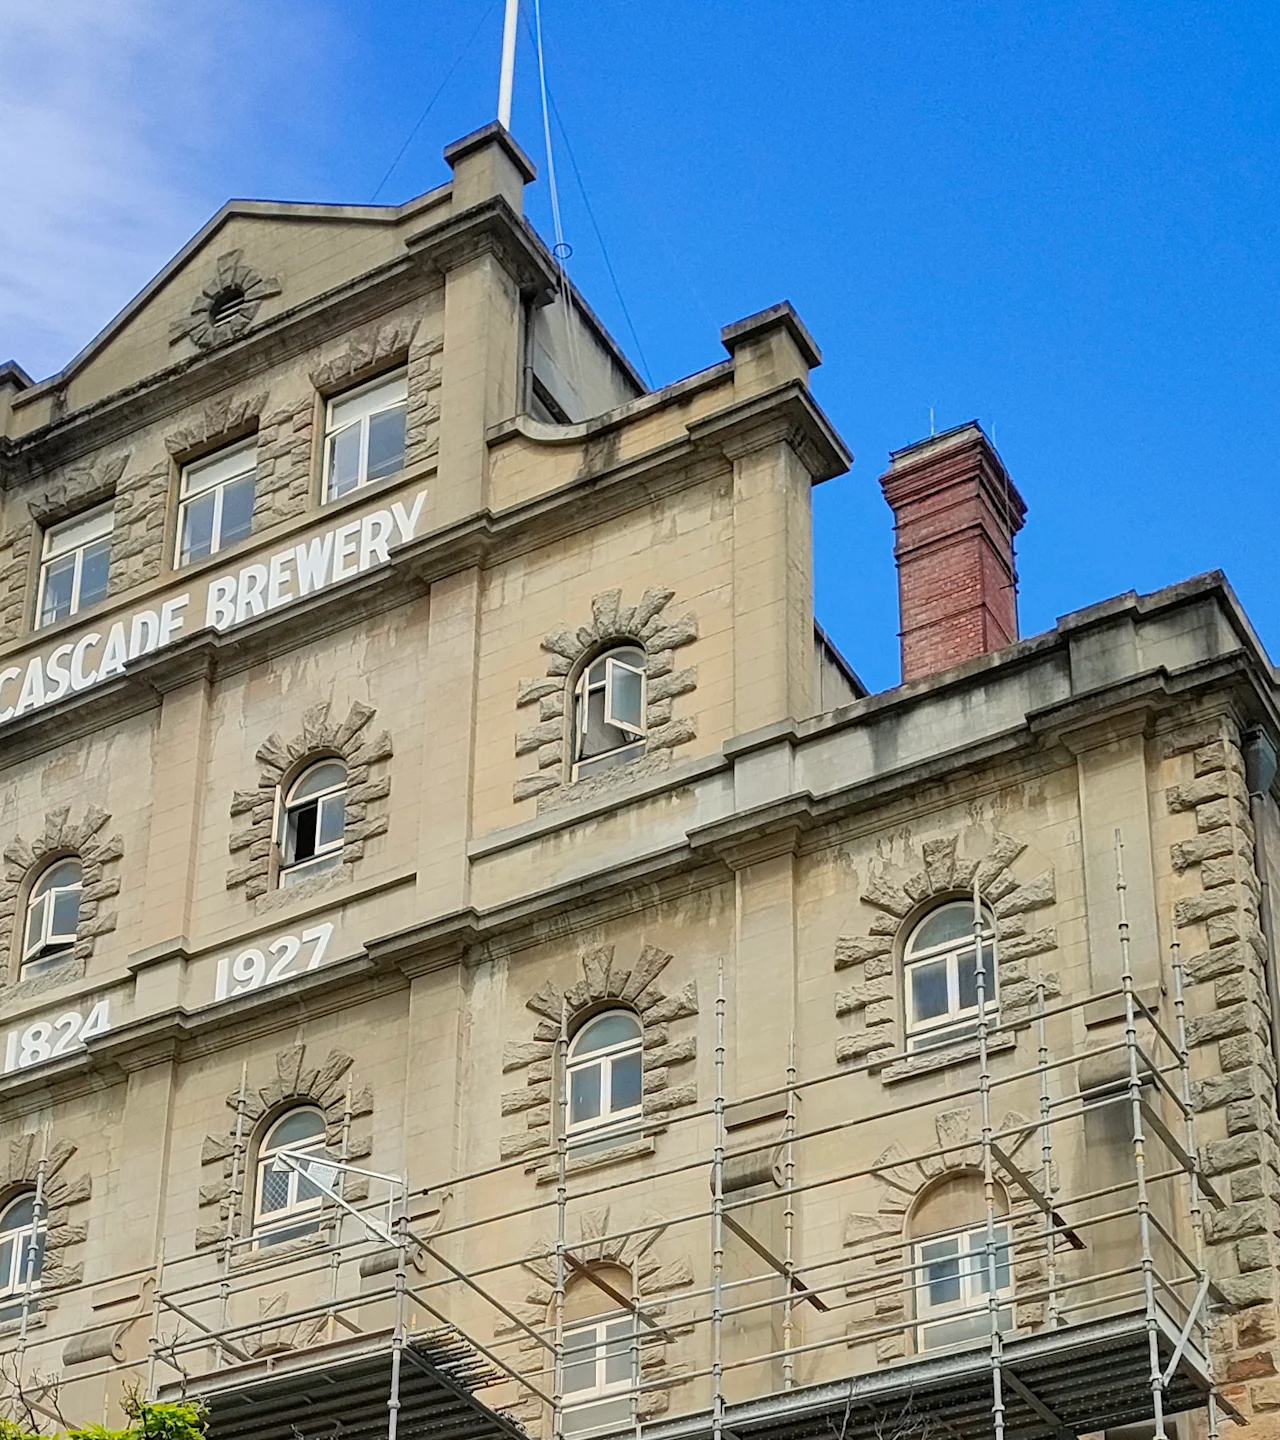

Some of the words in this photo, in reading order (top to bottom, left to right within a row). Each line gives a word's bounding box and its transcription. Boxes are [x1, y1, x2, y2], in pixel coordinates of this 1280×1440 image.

[205, 490, 428, 631] BREWERY
[4, 1000, 111, 1073] 1824
[215, 922, 334, 1002] 1927
